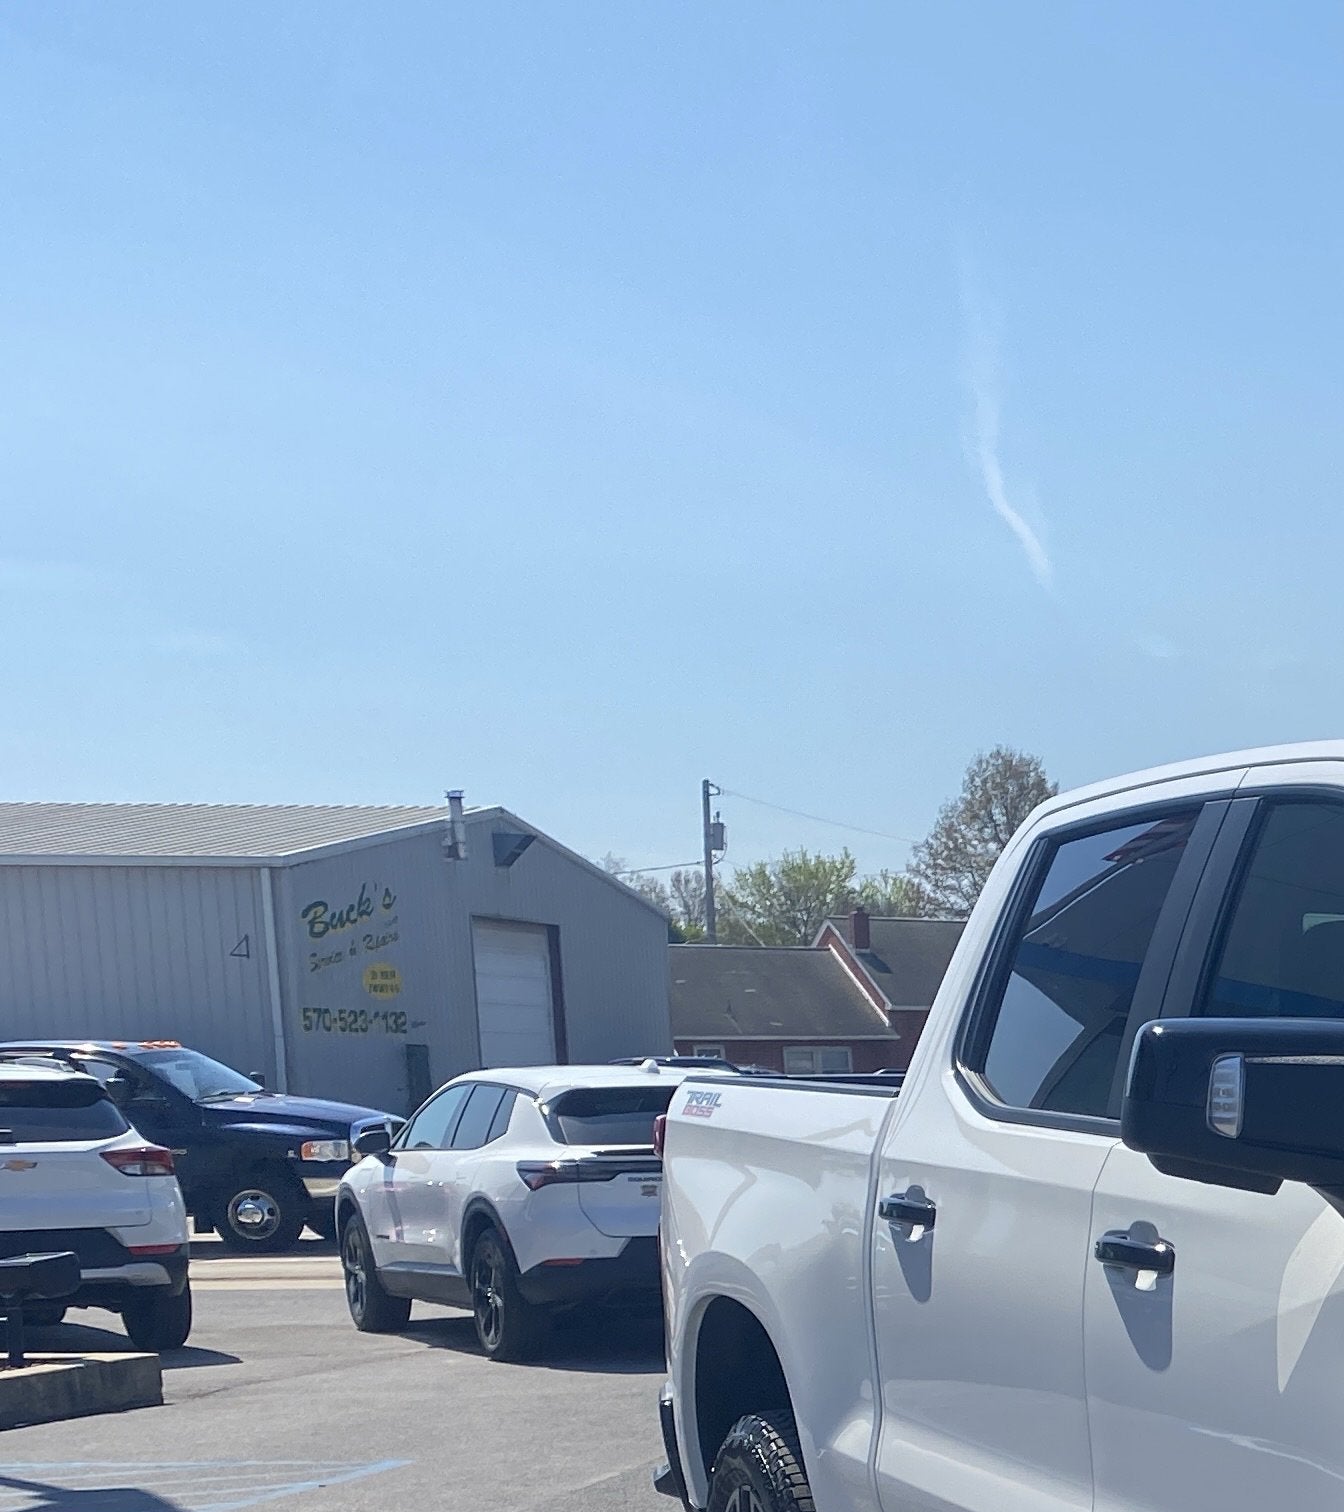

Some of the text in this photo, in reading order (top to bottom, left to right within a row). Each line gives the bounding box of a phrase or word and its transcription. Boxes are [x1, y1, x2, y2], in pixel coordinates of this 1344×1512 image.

[301, 882, 397, 938] Buck's
[686, 1090, 722, 1107] TRAIL
[681, 1104, 715, 1118] BOSS
